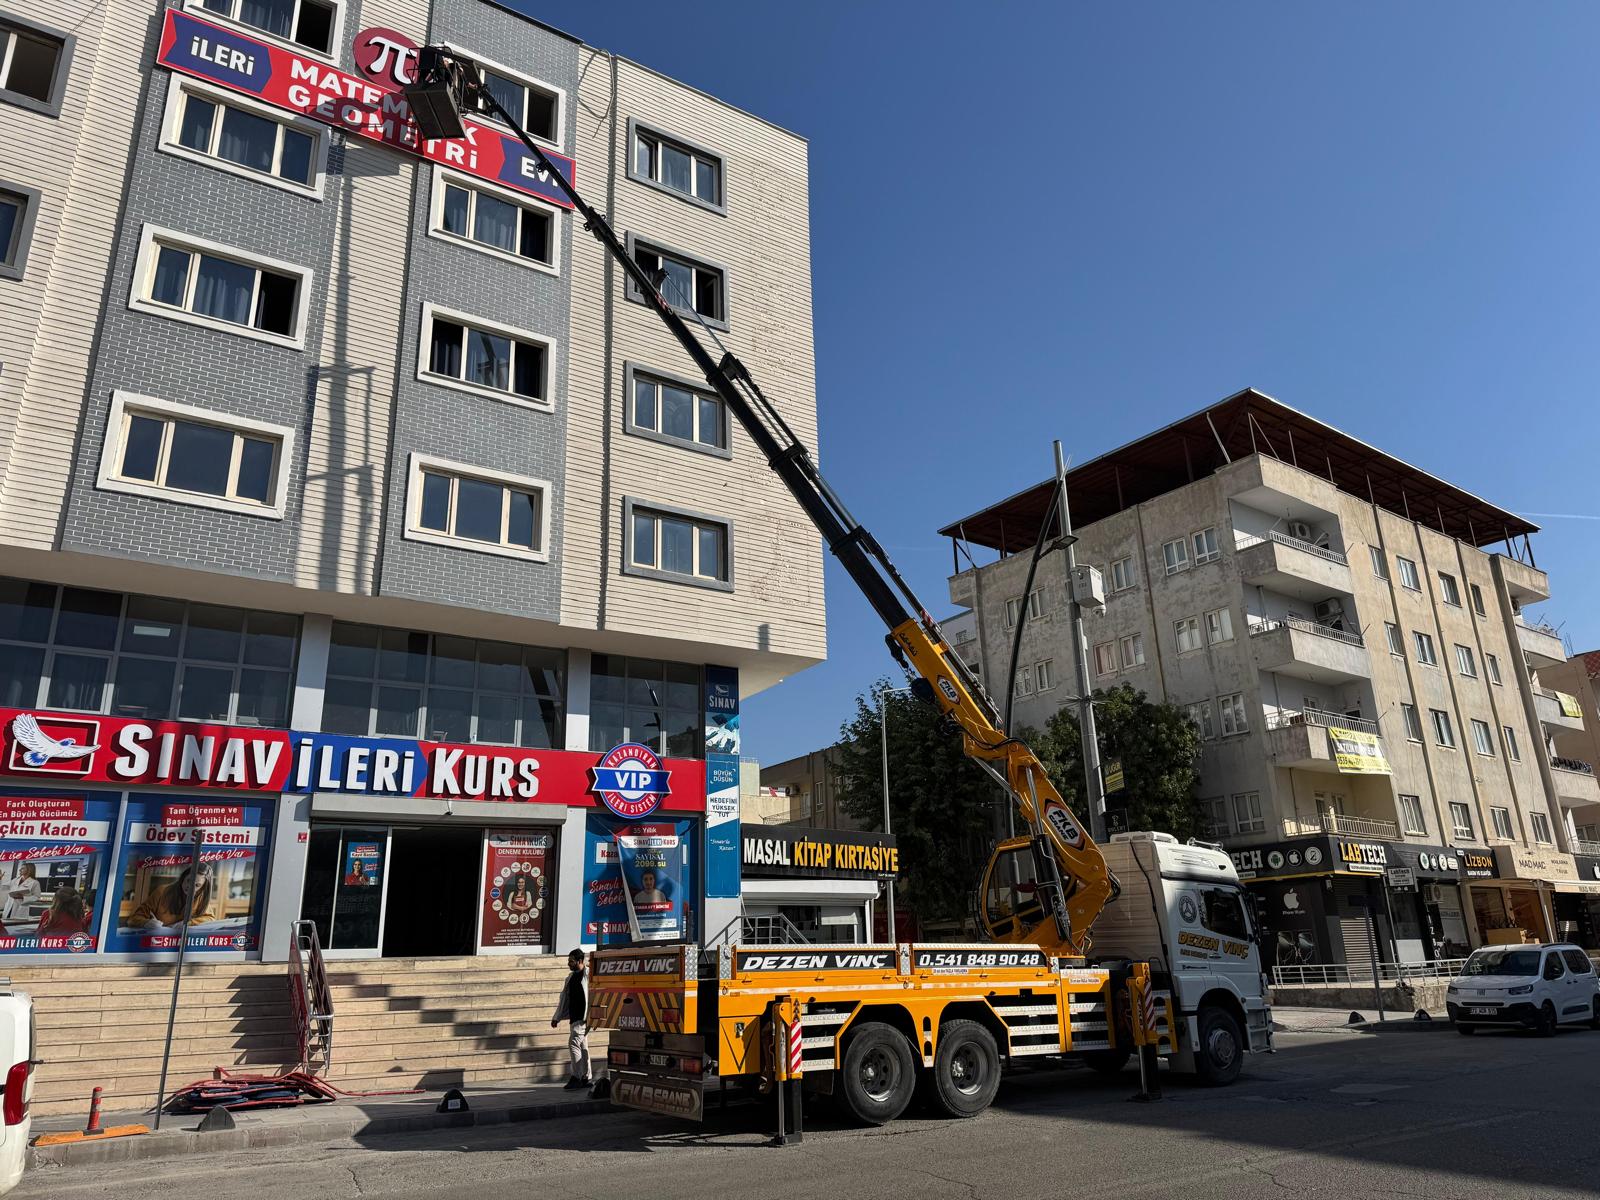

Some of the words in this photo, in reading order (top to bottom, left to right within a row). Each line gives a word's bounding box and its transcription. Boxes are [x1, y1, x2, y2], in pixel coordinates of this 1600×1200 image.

[709, 695, 736, 709] SINAV
[115, 723, 283, 785] SINAV
[432, 747, 540, 799] KURS
[607, 748, 657, 769] KAZANDIRAN
[614, 771, 652, 789] VIP
[6, 800, 26, 808] Fark
[28, 800, 71, 809] Oluşturan
[168, 807, 186, 815] Tam
[188, 805, 226, 816] Öğrenme
[11, 810, 37, 819] Büyük
[39, 810, 78, 818] Gücümüz
[166, 817, 194, 826] Başarı
[196, 817, 221, 825] Takibi
[223, 815, 239, 826] İçin
[39, 822, 87, 837] Kadro
[1052, 809, 1079, 840] FKB
[145, 824, 186, 842] Ödev
[26, 844, 62, 860] Sebebi
[64, 843, 84, 856] Var
[226, 847, 245, 859] Var
[743, 837, 791, 866] MASAL
[794, 835, 832, 868] KİTAP
[835, 841, 899, 872] KIRTASİYE
[1339, 842, 1388, 864] LABTECH
[40, 937, 63, 949] KURS
[208, 936, 228, 947] KURS
[598, 959, 641, 974] DEZEN
[742, 954, 828, 971] DEZEN
[919, 953, 963, 966] 0.541
[966, 953, 997, 966] 848
[999, 953, 1019, 966] 90
[1020, 953, 1040, 966] 48
